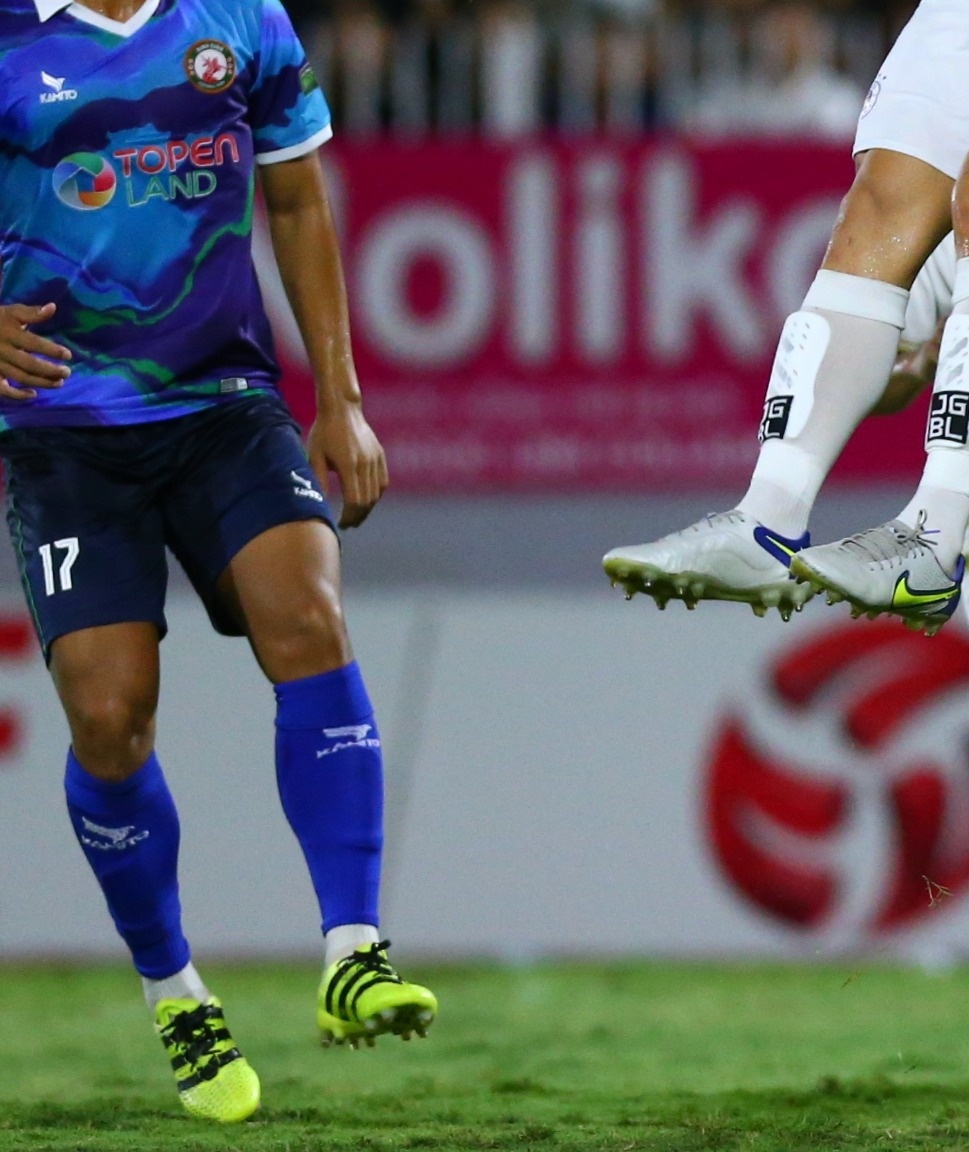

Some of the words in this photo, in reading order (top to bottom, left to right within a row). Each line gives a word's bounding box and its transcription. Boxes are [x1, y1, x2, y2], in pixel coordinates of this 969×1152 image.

[125, 169, 218, 207] LAND
[931, 393, 969, 417] JG
[929, 416, 963, 441] BL
[38, 536, 80, 596] 17
